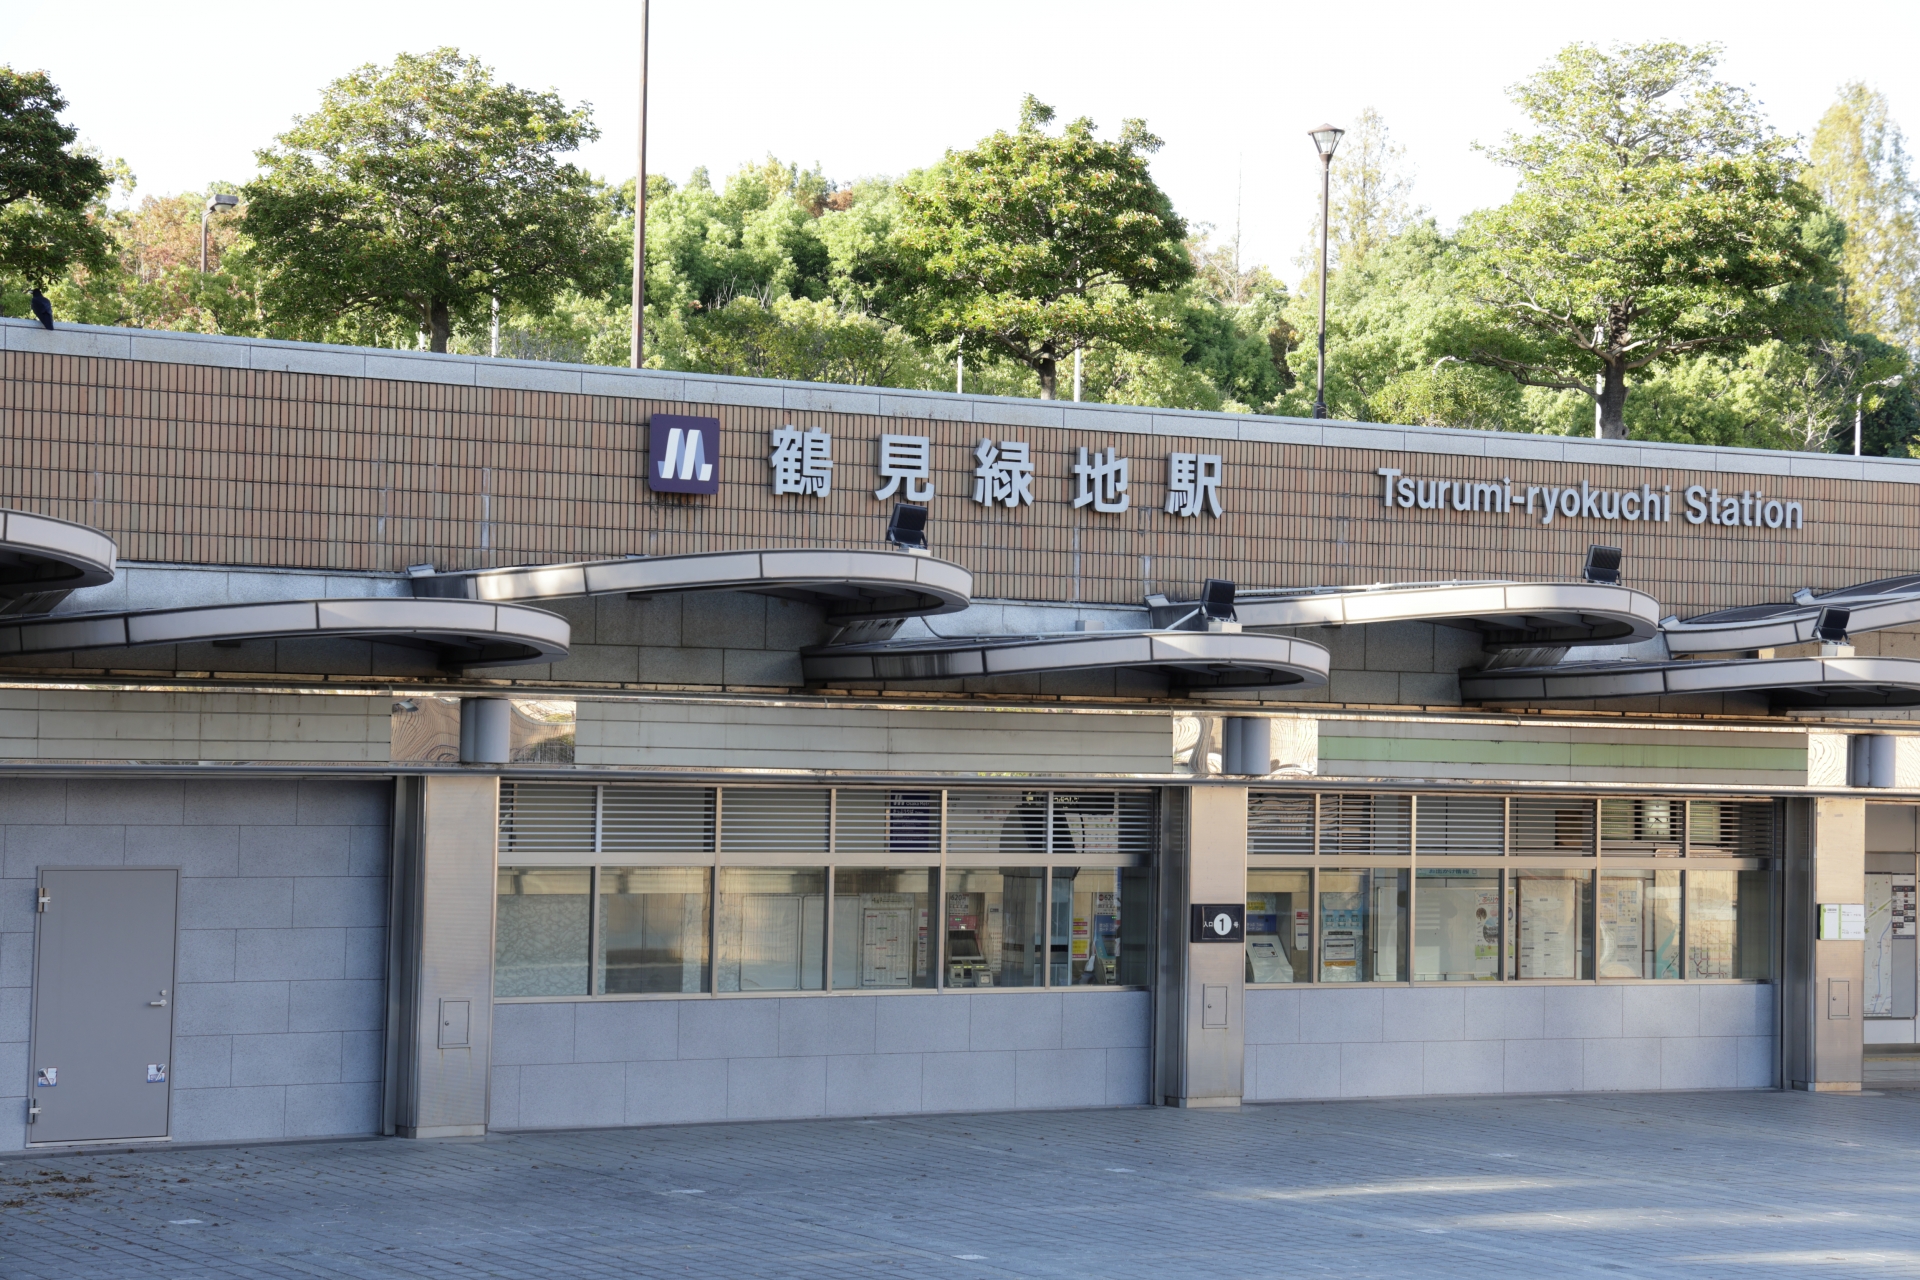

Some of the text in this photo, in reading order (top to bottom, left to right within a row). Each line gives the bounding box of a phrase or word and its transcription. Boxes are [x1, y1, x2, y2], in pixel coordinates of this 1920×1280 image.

[768, 424, 1223, 519] 鶴見緑地駅
[1377, 467, 1803, 529] Tsurumi-ryokuchi Station
